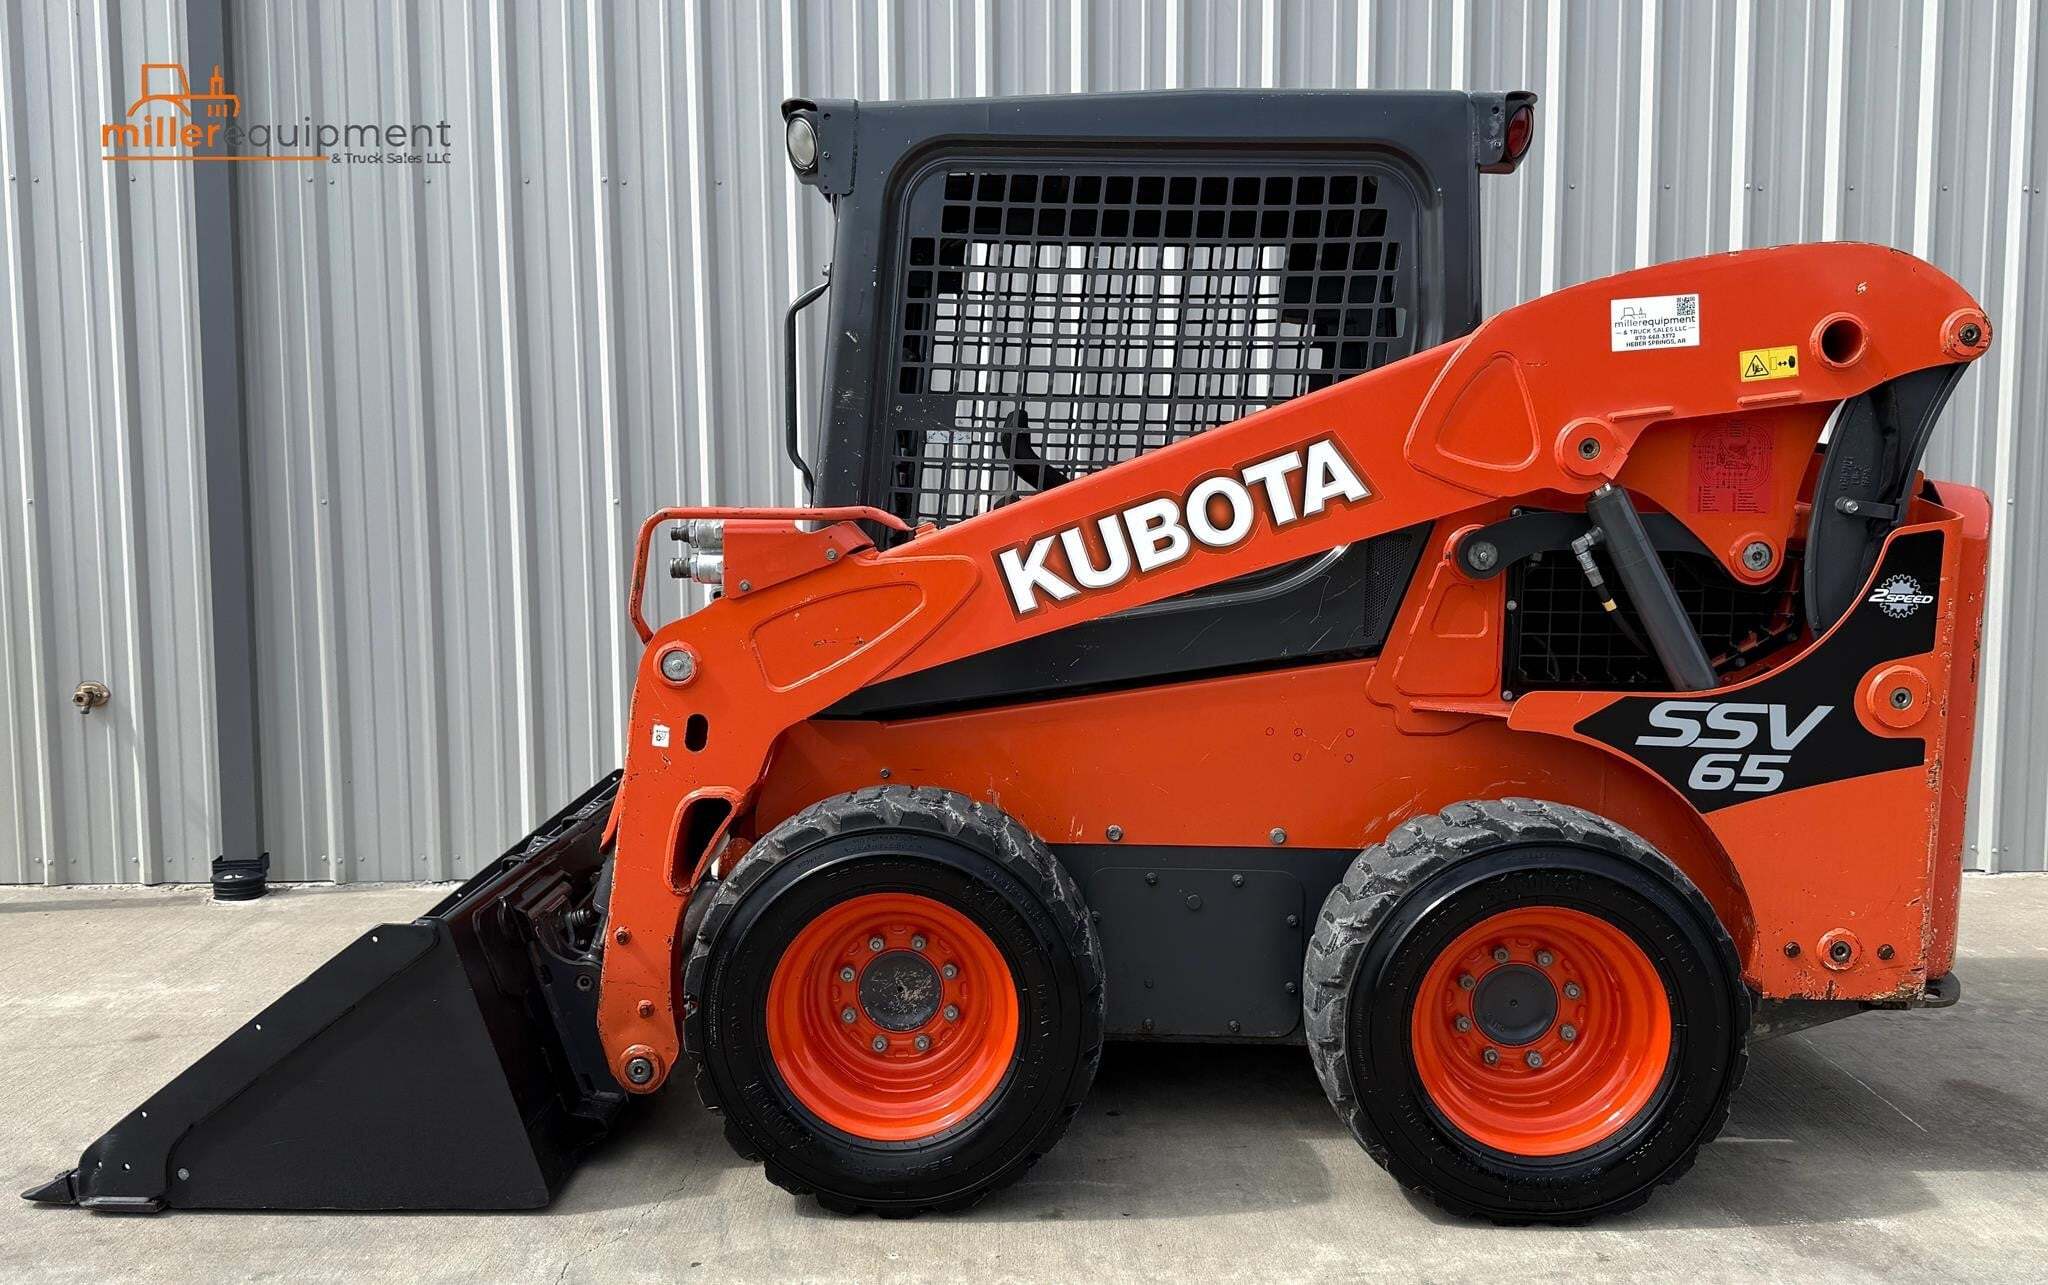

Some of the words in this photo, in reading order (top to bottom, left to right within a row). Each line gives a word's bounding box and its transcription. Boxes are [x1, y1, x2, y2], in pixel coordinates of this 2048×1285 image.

[998, 438, 1371, 614] KUBOTA
[1635, 700, 1835, 751] SSV
[1688, 753, 1791, 792] 65
